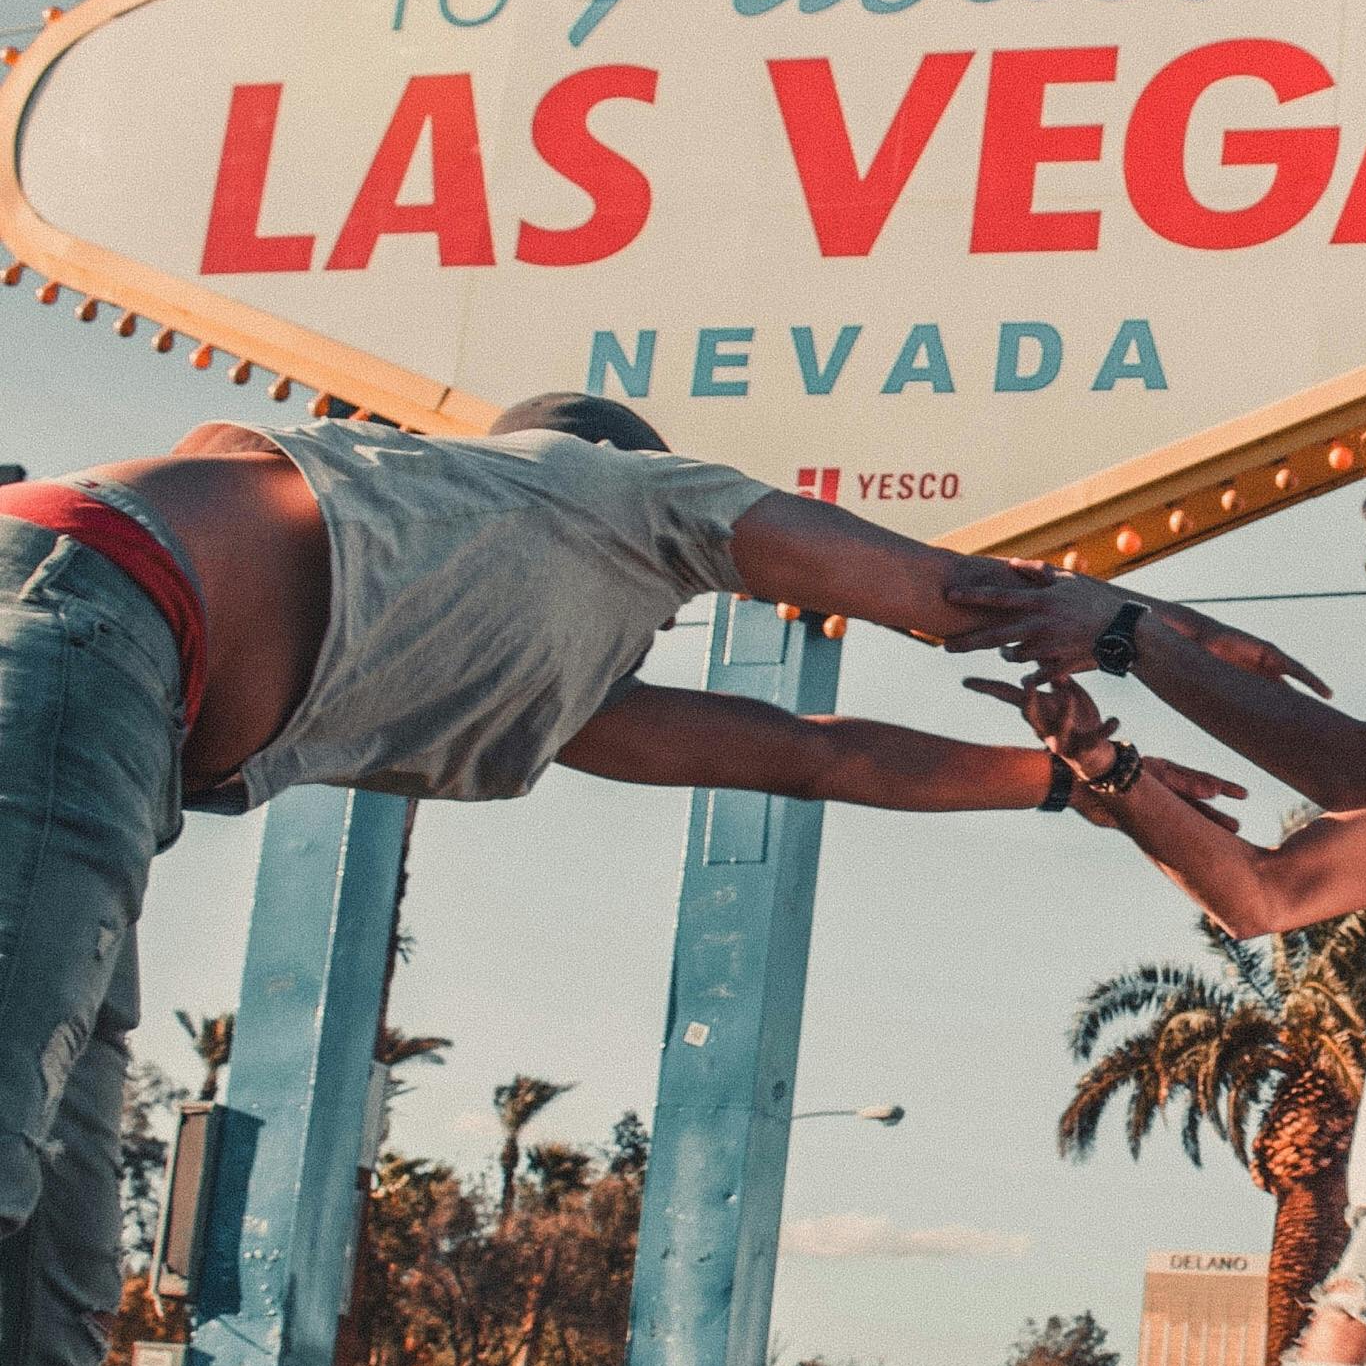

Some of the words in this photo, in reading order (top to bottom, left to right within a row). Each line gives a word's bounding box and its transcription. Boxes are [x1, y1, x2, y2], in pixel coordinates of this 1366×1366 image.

[199, 63, 661, 277] LAS
[585, 319, 1169, 399] NEVADA
[857, 471, 961, 501] YESCO
[1169, 1253, 1248, 1271] DELANO
